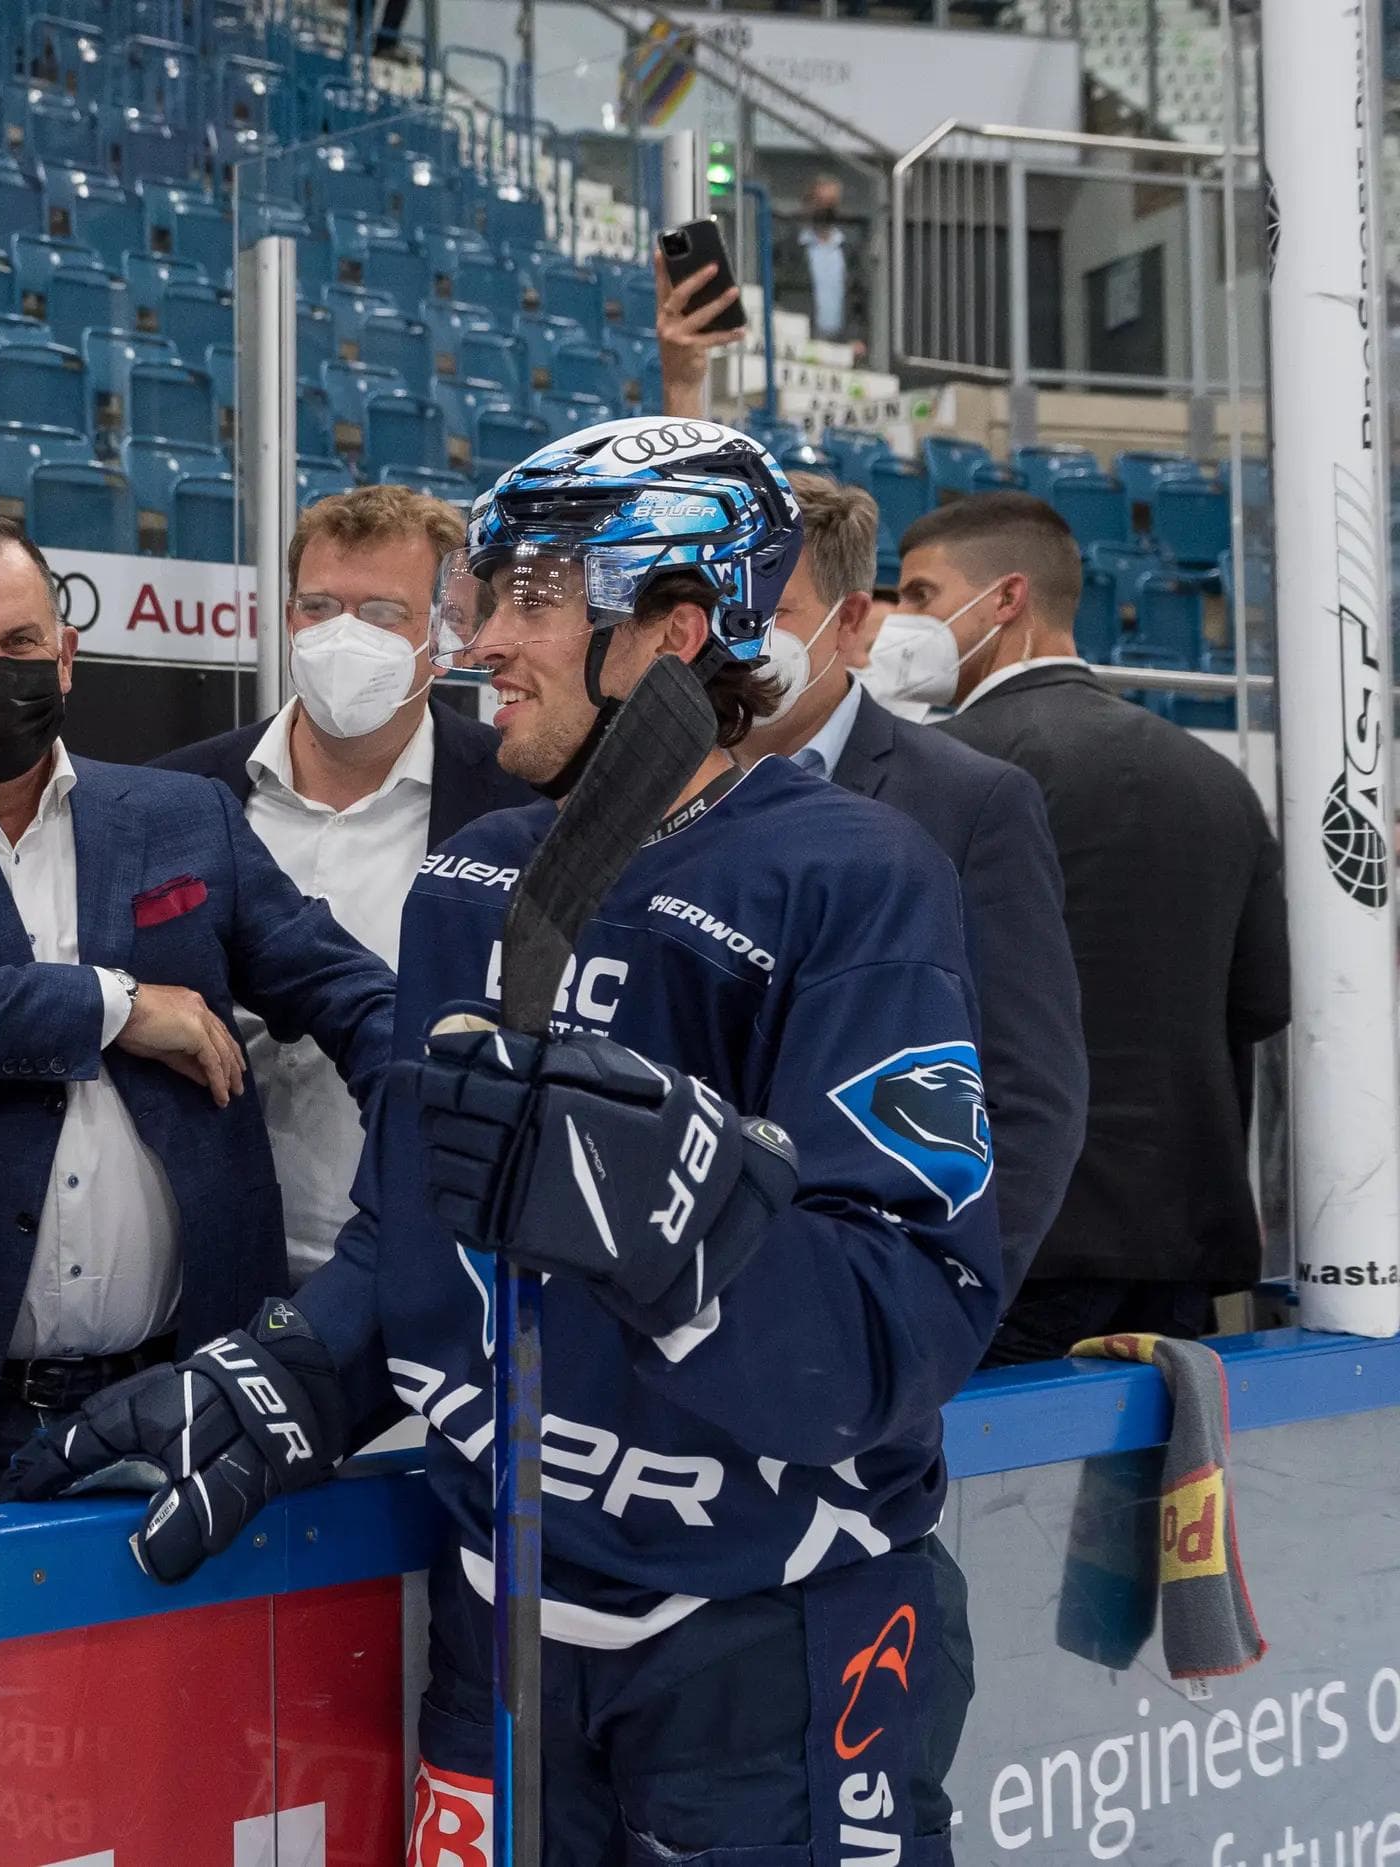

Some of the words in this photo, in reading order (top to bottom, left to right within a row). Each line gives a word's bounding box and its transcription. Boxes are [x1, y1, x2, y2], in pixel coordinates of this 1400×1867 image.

[126, 583, 258, 639] Audi
[648, 895, 776, 985] HERWOO
[989, 1680, 1349, 1860] engineers
[1212, 1812, 1400, 1867] ture
